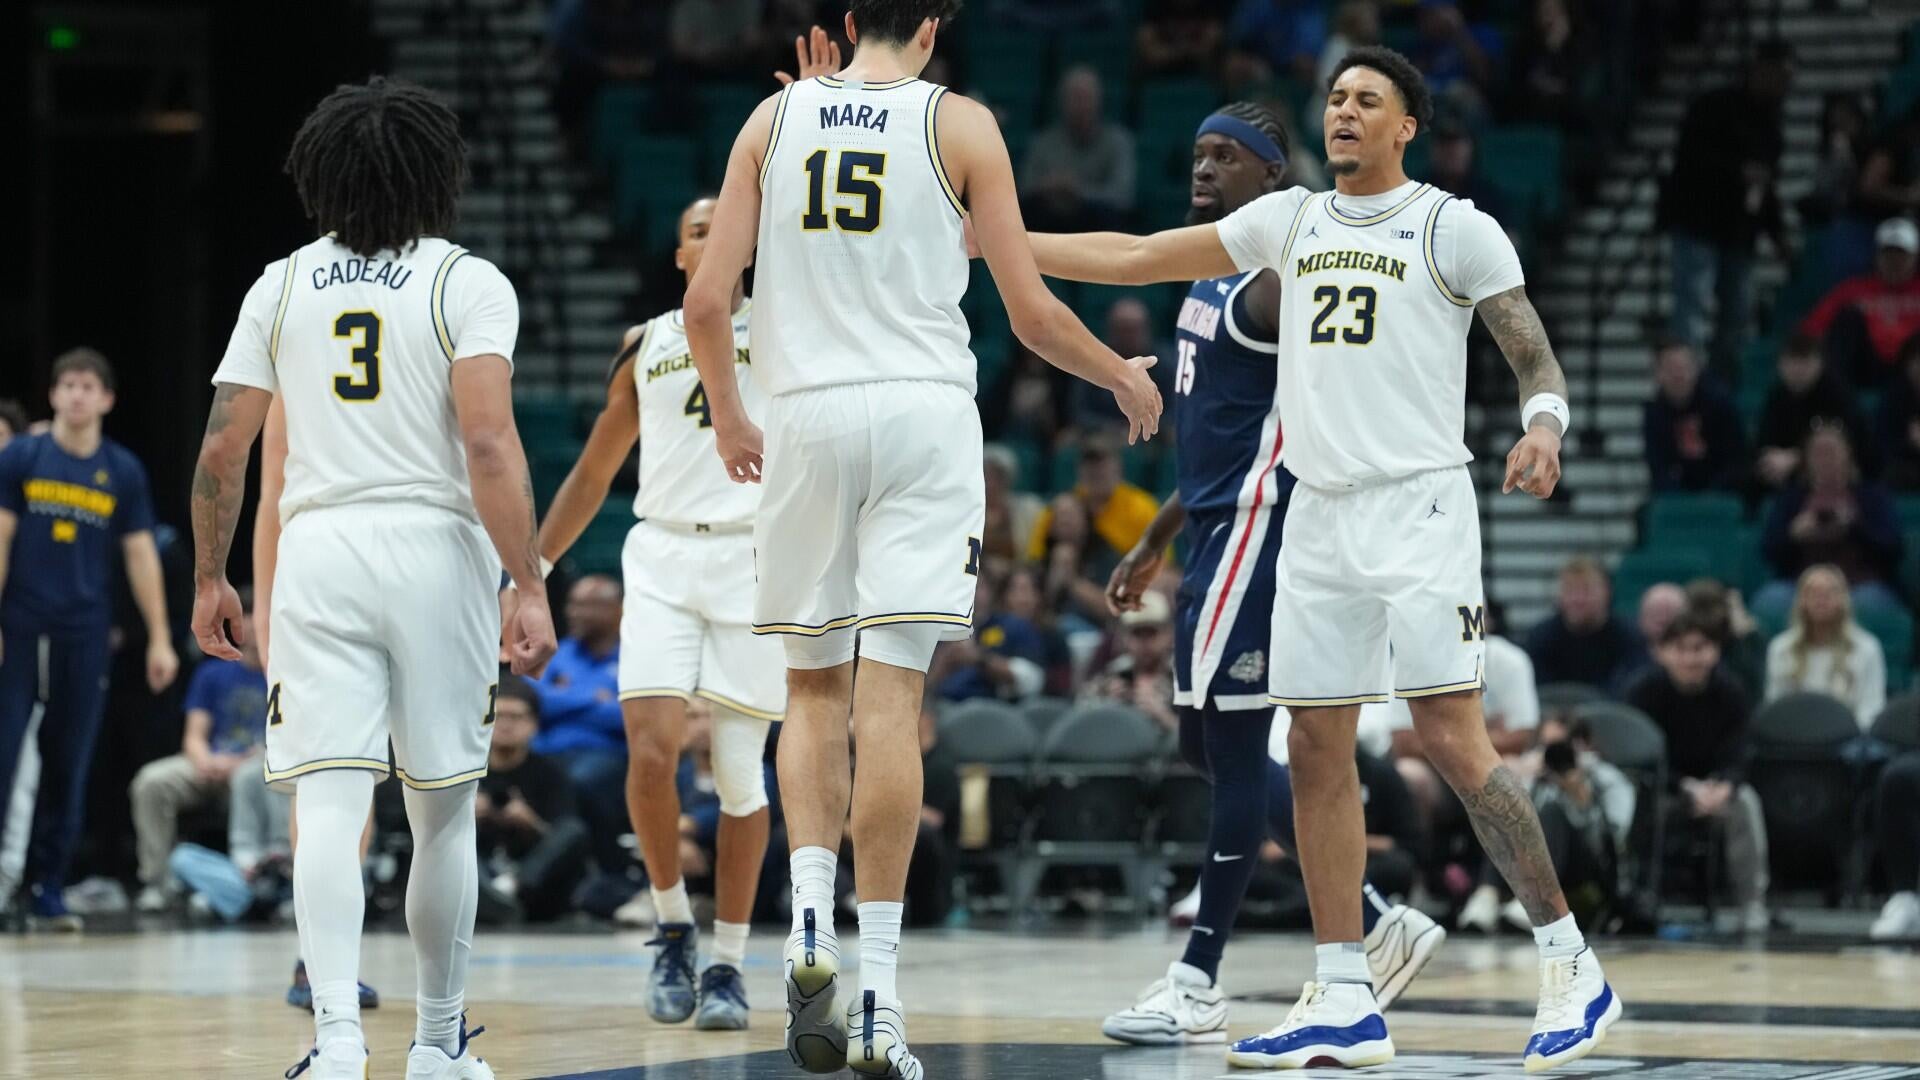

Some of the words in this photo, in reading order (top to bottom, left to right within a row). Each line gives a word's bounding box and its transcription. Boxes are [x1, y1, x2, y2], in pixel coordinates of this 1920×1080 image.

[820, 103, 889, 133] MARA
[802, 149, 887, 234] 15
[312, 258, 412, 290] CADEAU
[1296, 250, 1407, 282] MICHIGAN
[1310, 284, 1378, 345] 23
[332, 308, 383, 403] 3
[1174, 338, 1197, 397] 15
[683, 379, 713, 429] 4
[1456, 604, 1485, 642] M
